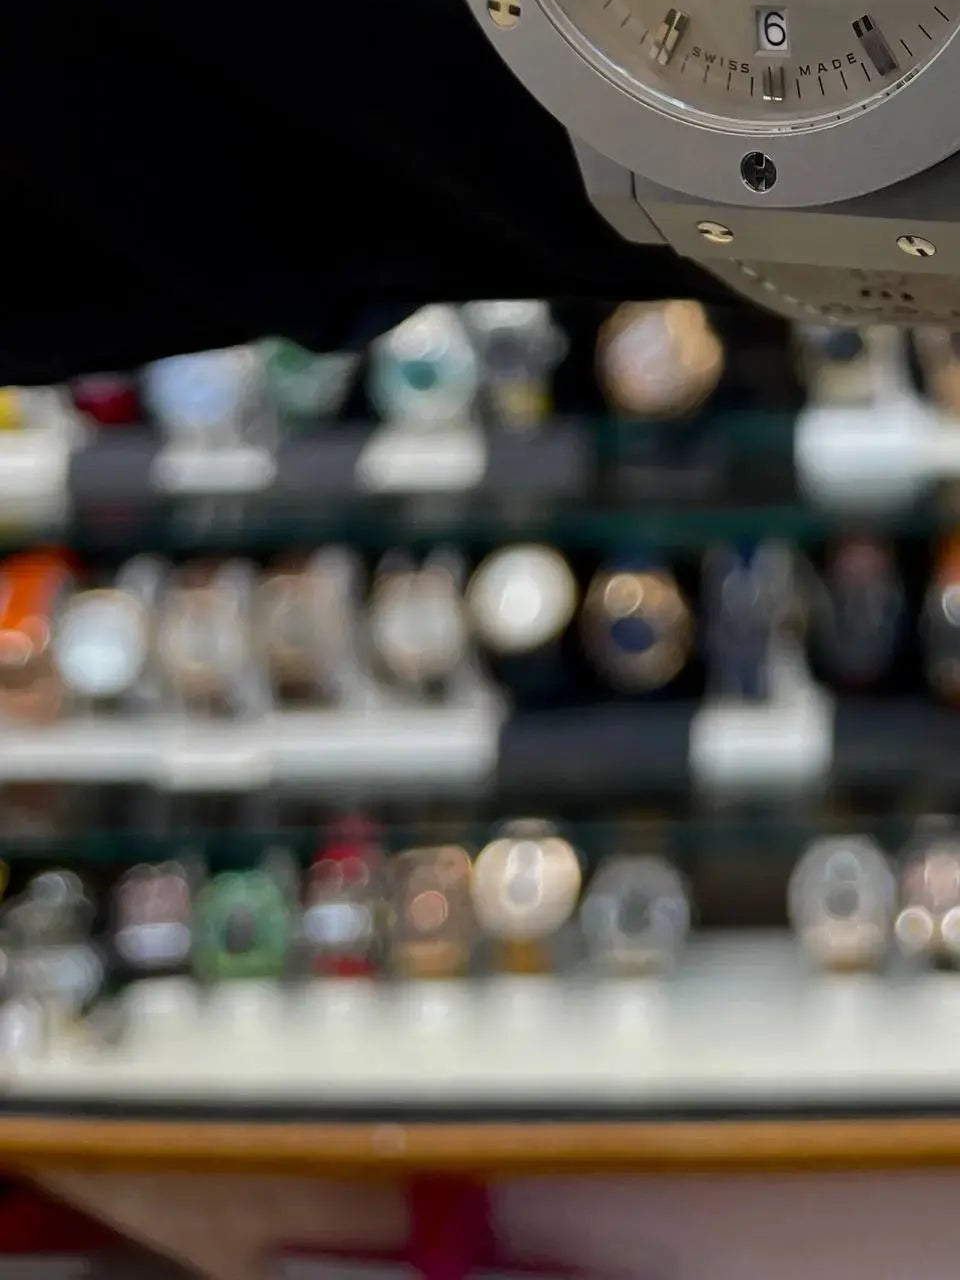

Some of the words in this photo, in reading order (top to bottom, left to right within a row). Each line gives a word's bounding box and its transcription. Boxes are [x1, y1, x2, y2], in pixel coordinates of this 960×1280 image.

[764, 11, 786, 47] 6
[692, 46, 751, 74] SWISS
[799, 52, 857, 76] MADE
